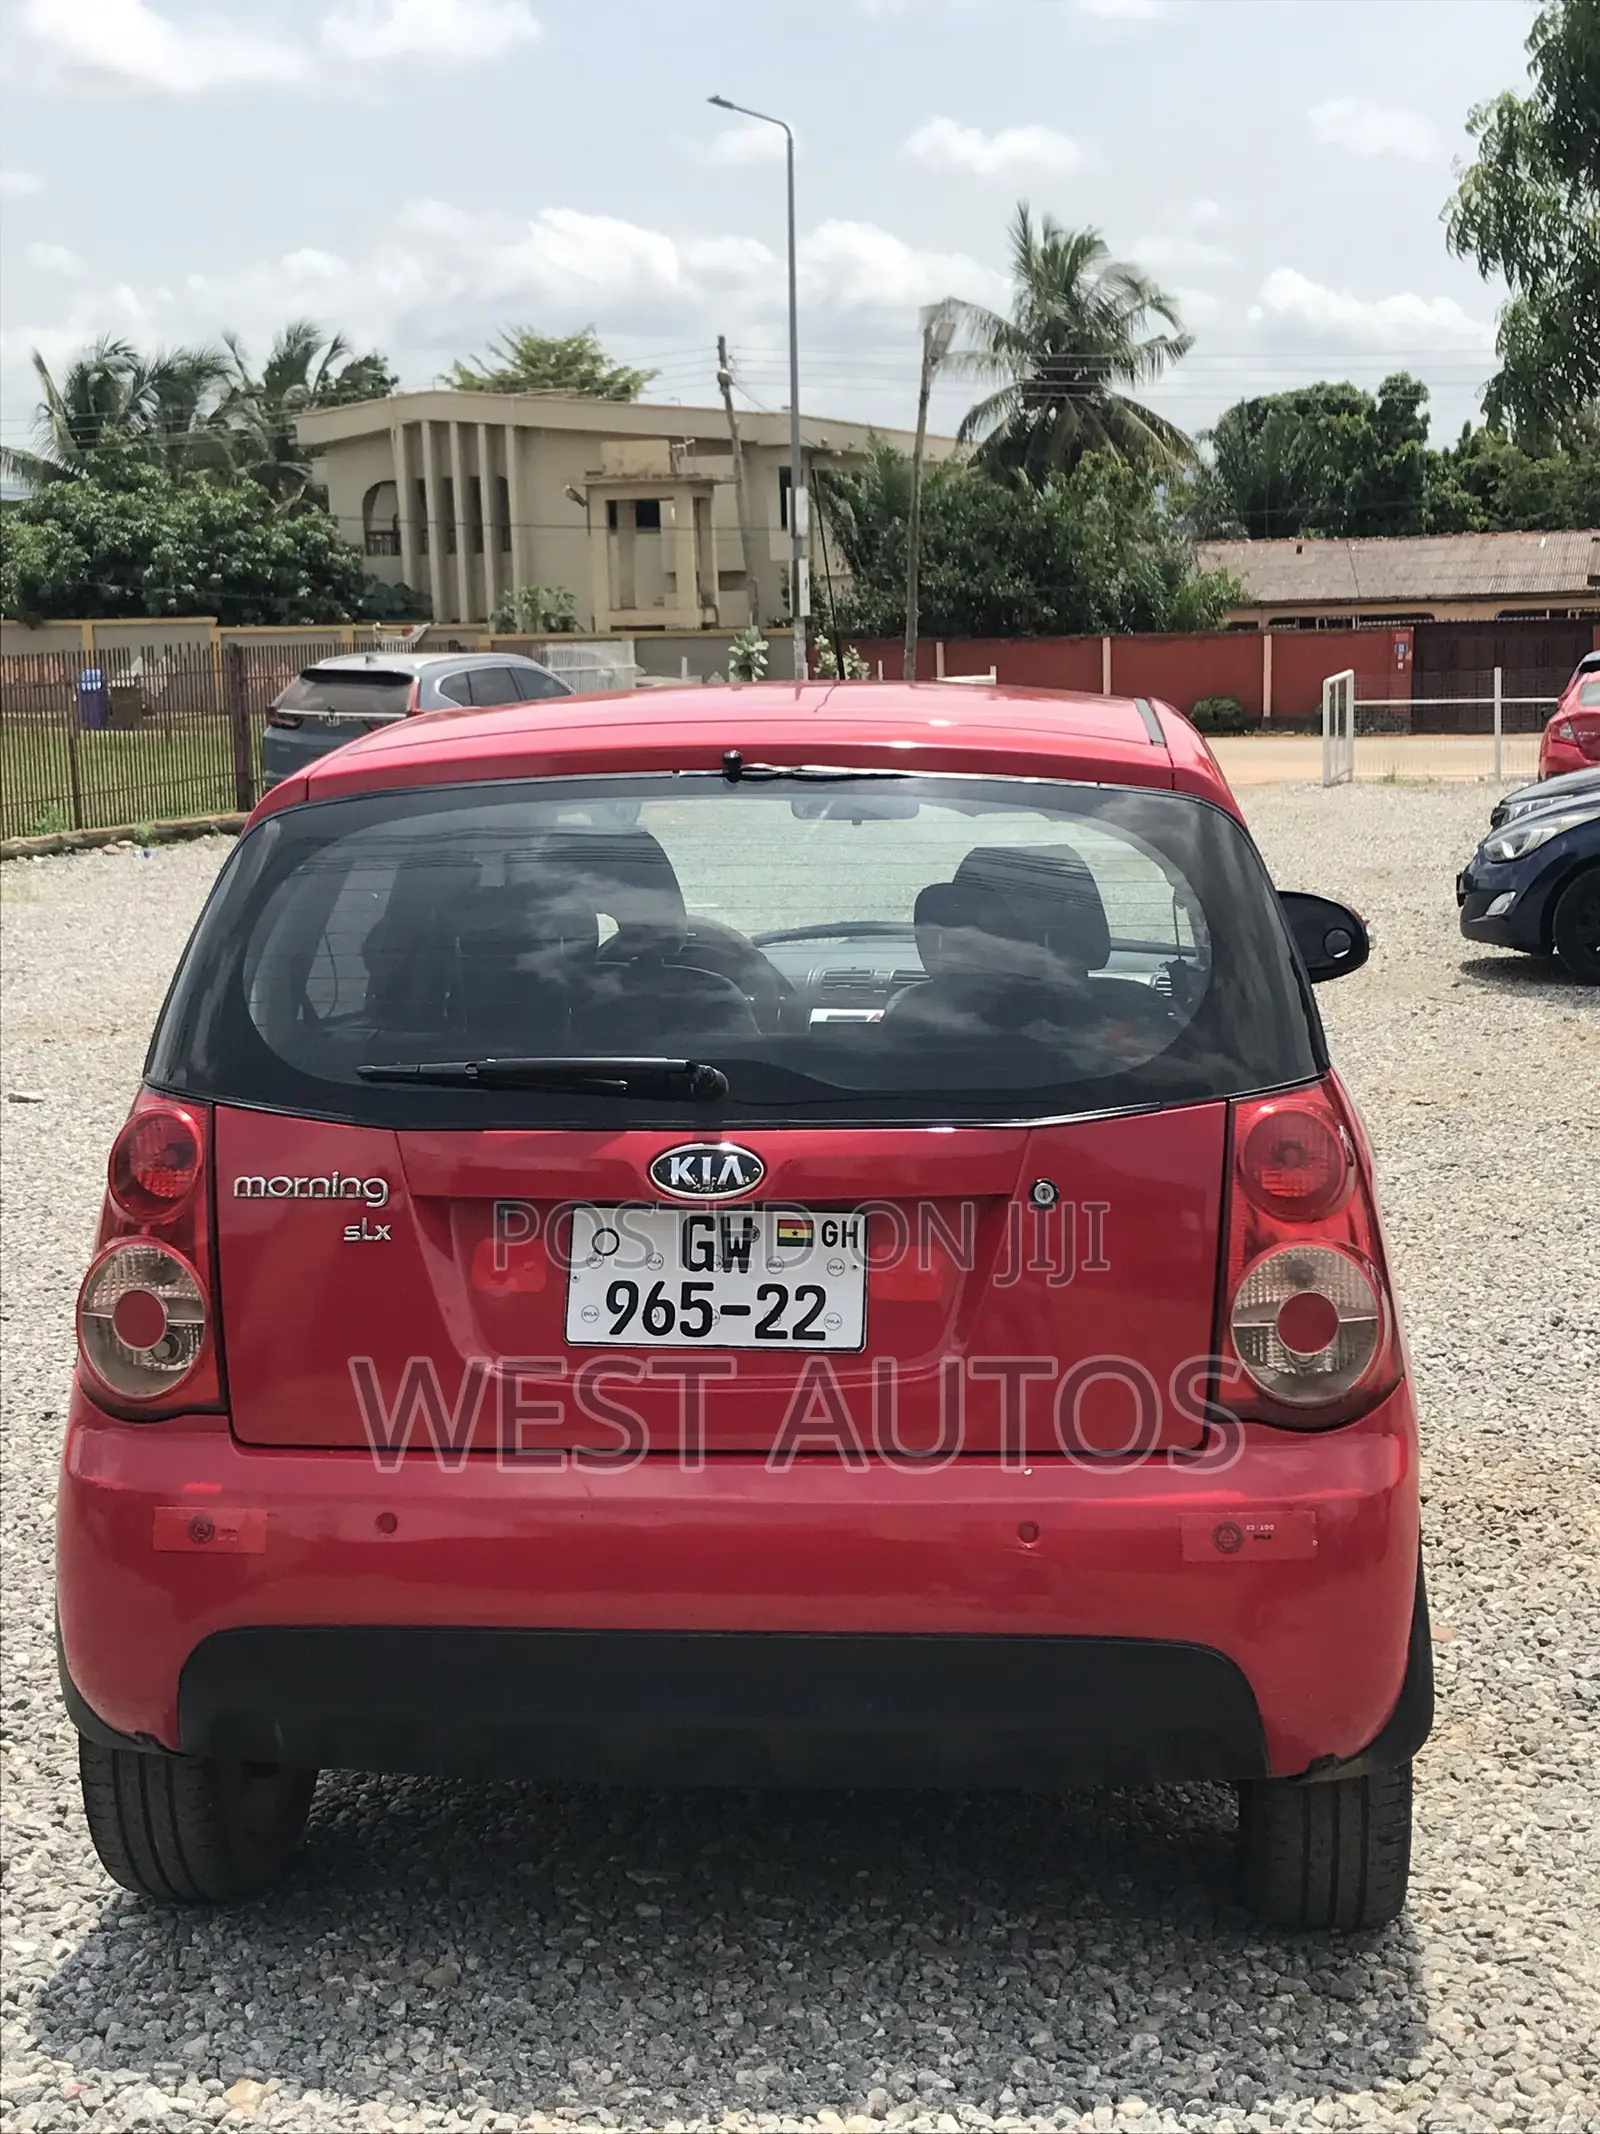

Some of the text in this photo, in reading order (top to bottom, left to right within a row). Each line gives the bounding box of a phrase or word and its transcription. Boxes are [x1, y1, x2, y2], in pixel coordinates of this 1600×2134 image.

[233, 1170, 389, 1208] morning
[669, 1155, 747, 1186] KIA
[681, 1215, 859, 1273] GW GH
[605, 1279, 827, 1340] 965-22
